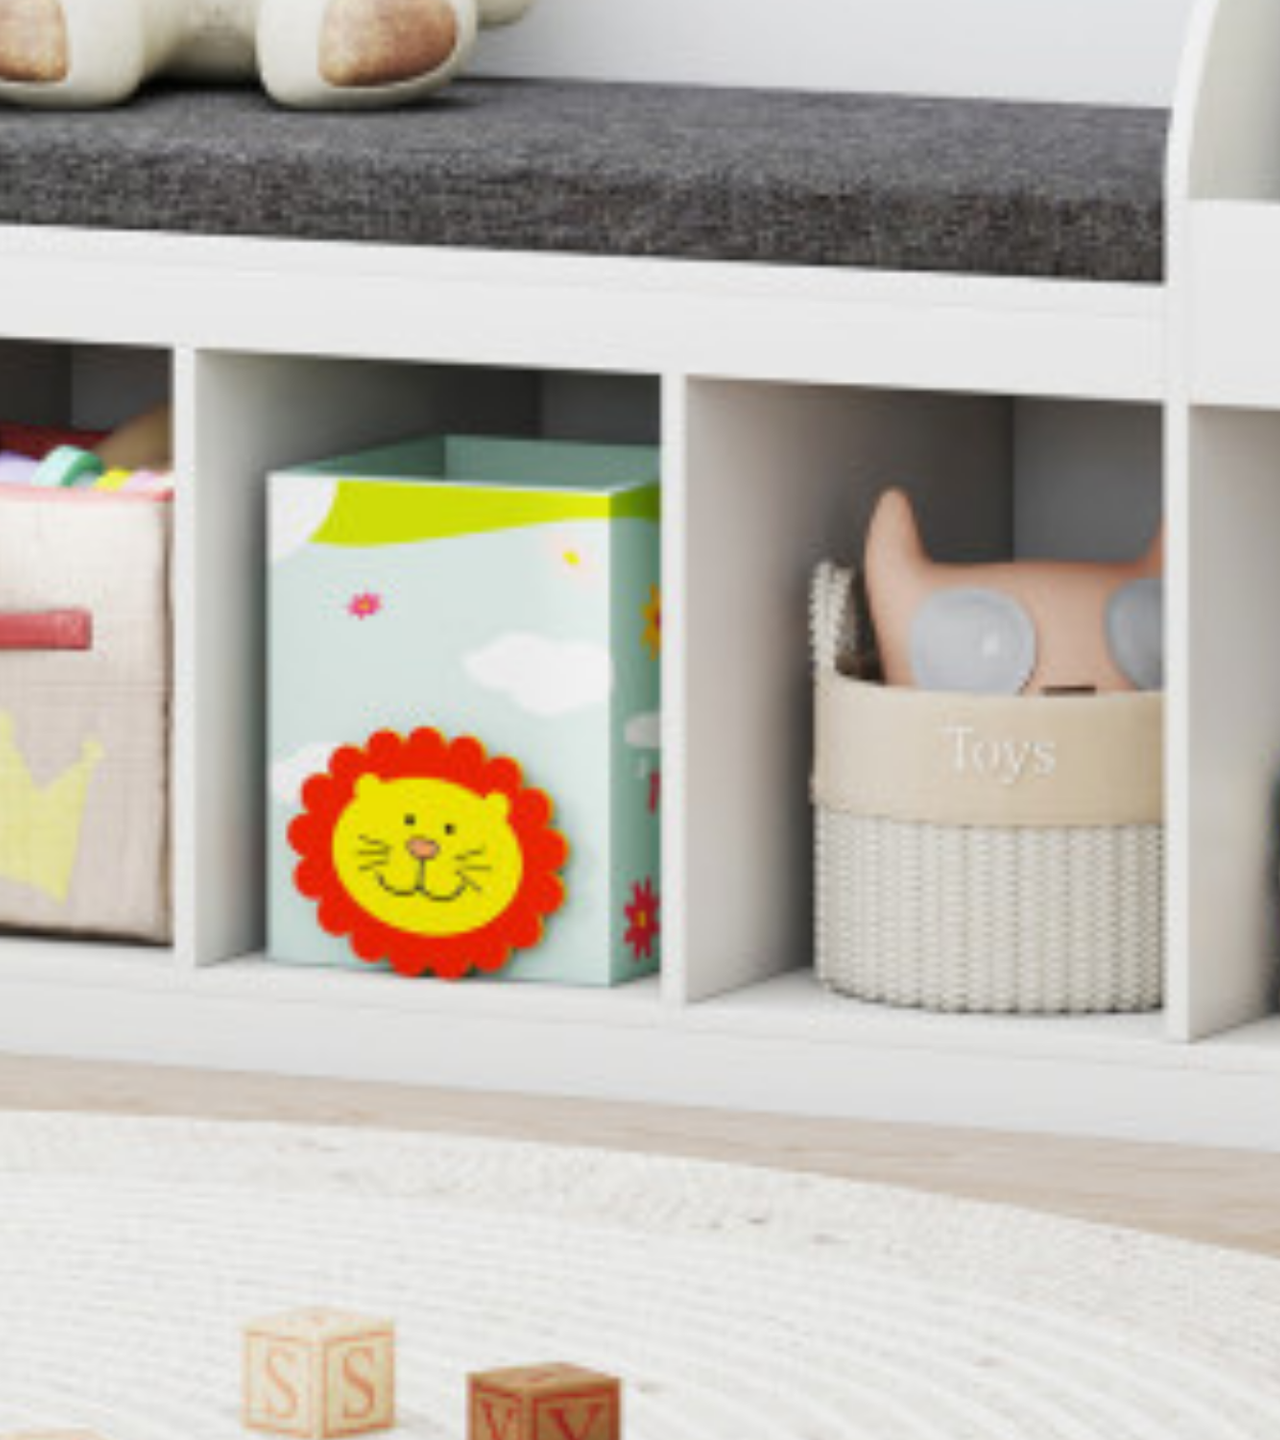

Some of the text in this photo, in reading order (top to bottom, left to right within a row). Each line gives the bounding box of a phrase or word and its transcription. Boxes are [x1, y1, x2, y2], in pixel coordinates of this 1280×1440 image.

[938, 724, 1057, 787] Toys
[261, 1346, 299, 1420] S
[341, 1345, 376, 1420] S
